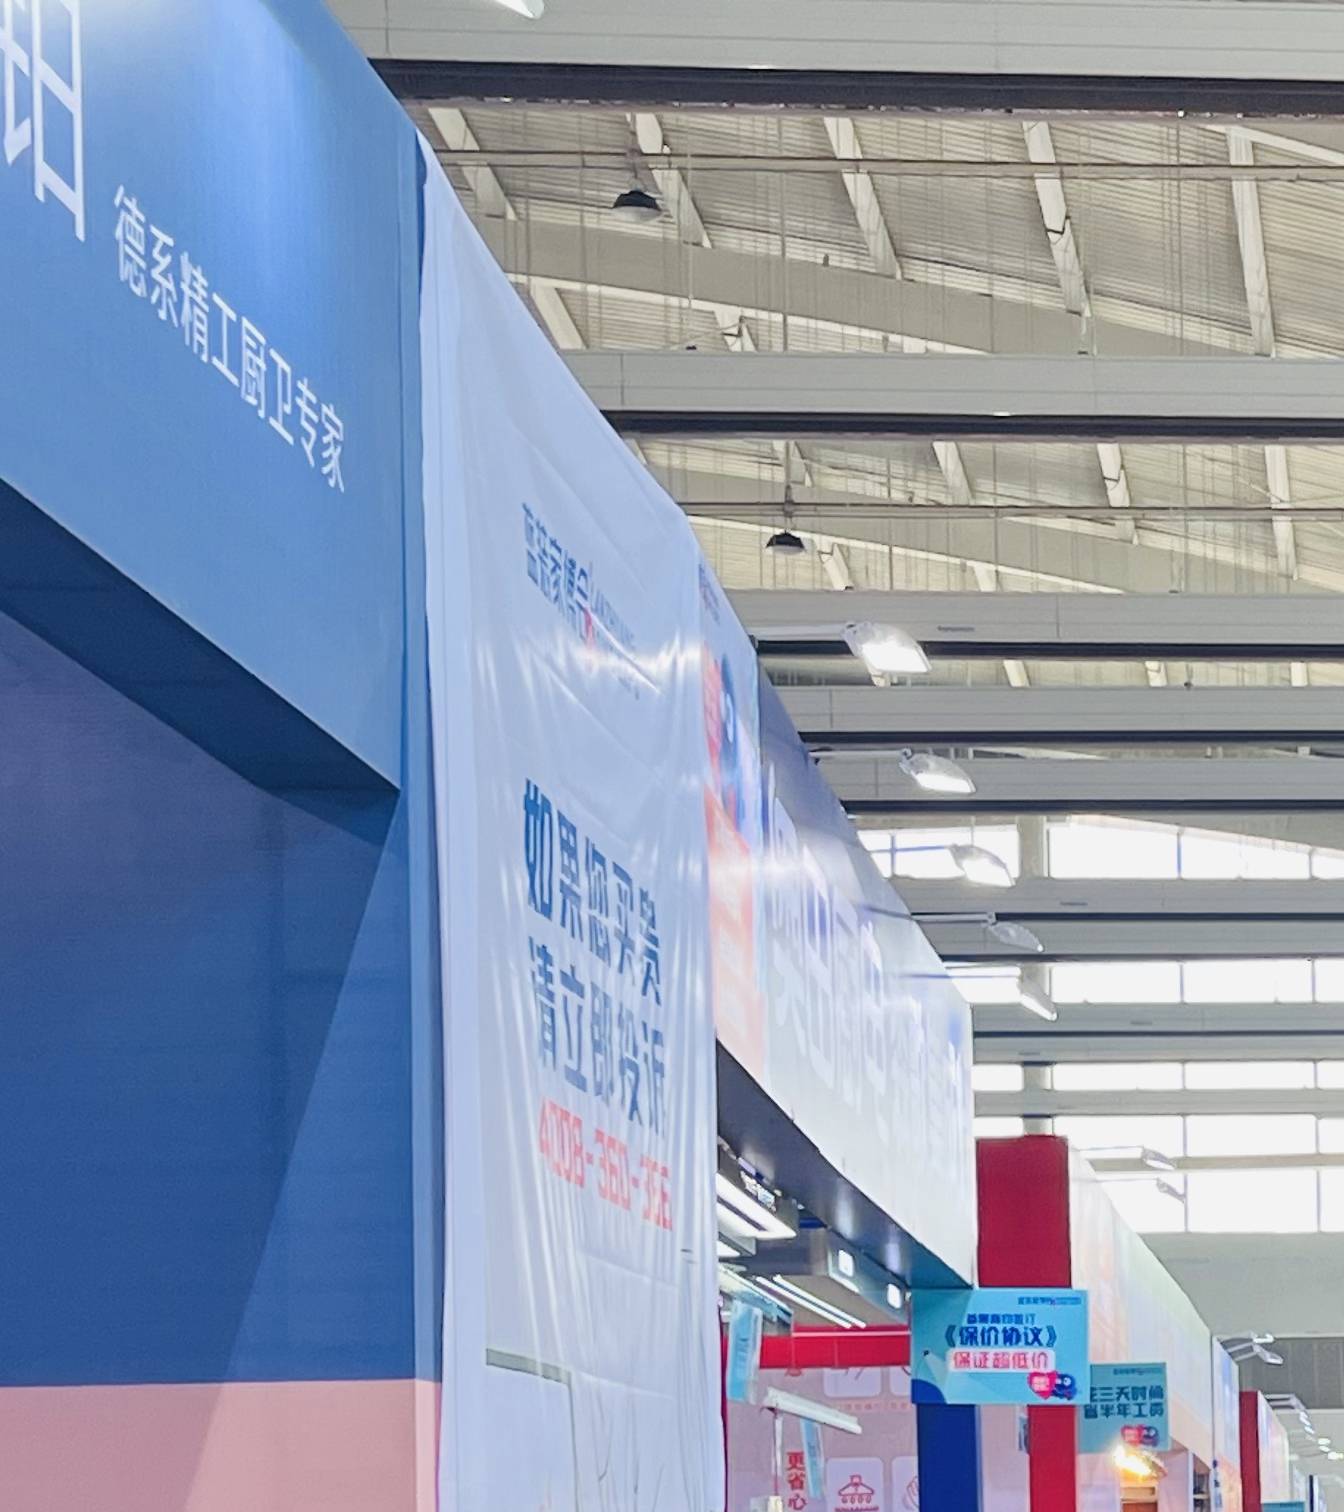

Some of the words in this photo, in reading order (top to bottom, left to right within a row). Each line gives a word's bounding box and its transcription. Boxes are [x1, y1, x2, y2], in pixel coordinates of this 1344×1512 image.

[114, 185, 345, 493] 德系精工厨卫专家
[528, 936, 666, 1138] 请立即投诉
[945, 1324, 1057, 1348] 《保价协议》
[953, 1351, 1048, 1369] 保证超低价
[786, 1451, 807, 1511] 更省心
